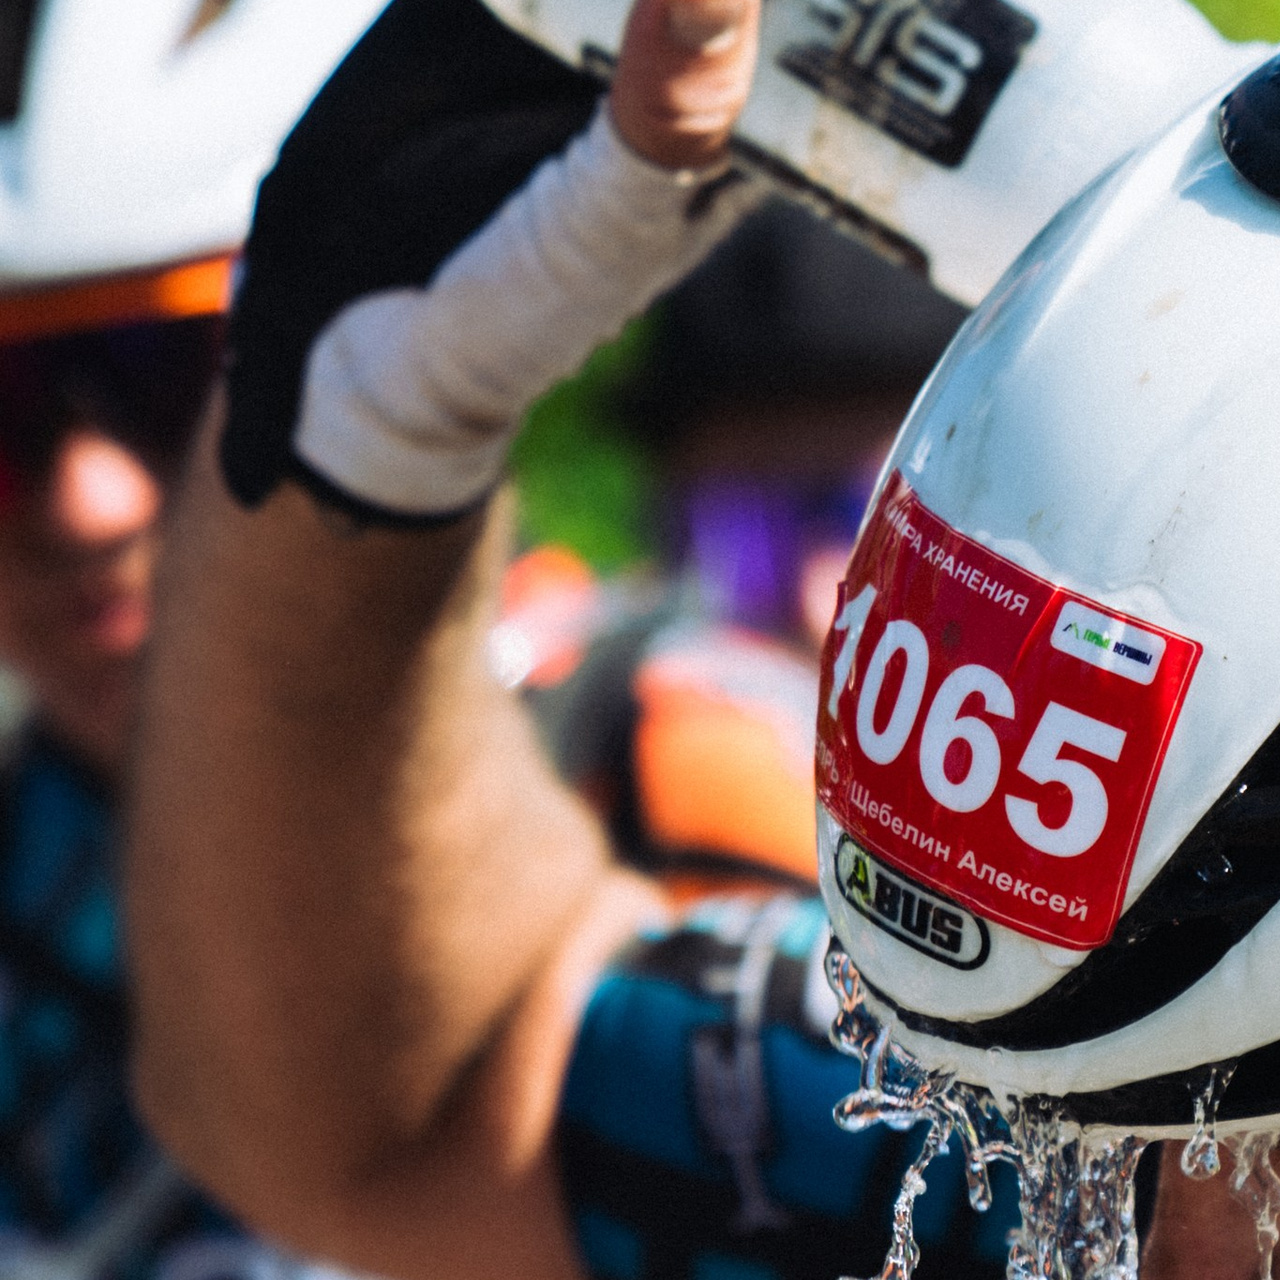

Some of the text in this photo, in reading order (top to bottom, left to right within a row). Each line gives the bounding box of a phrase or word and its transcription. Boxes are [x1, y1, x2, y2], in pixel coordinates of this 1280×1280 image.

[923, 541, 1030, 617] ХРАНЕНИЯ
[828, 582, 1128, 858] 1065
[845, 852, 964, 954] ABUS
[850, 780, 951, 862] Щебелин
[956, 850, 1089, 922] Алексей
